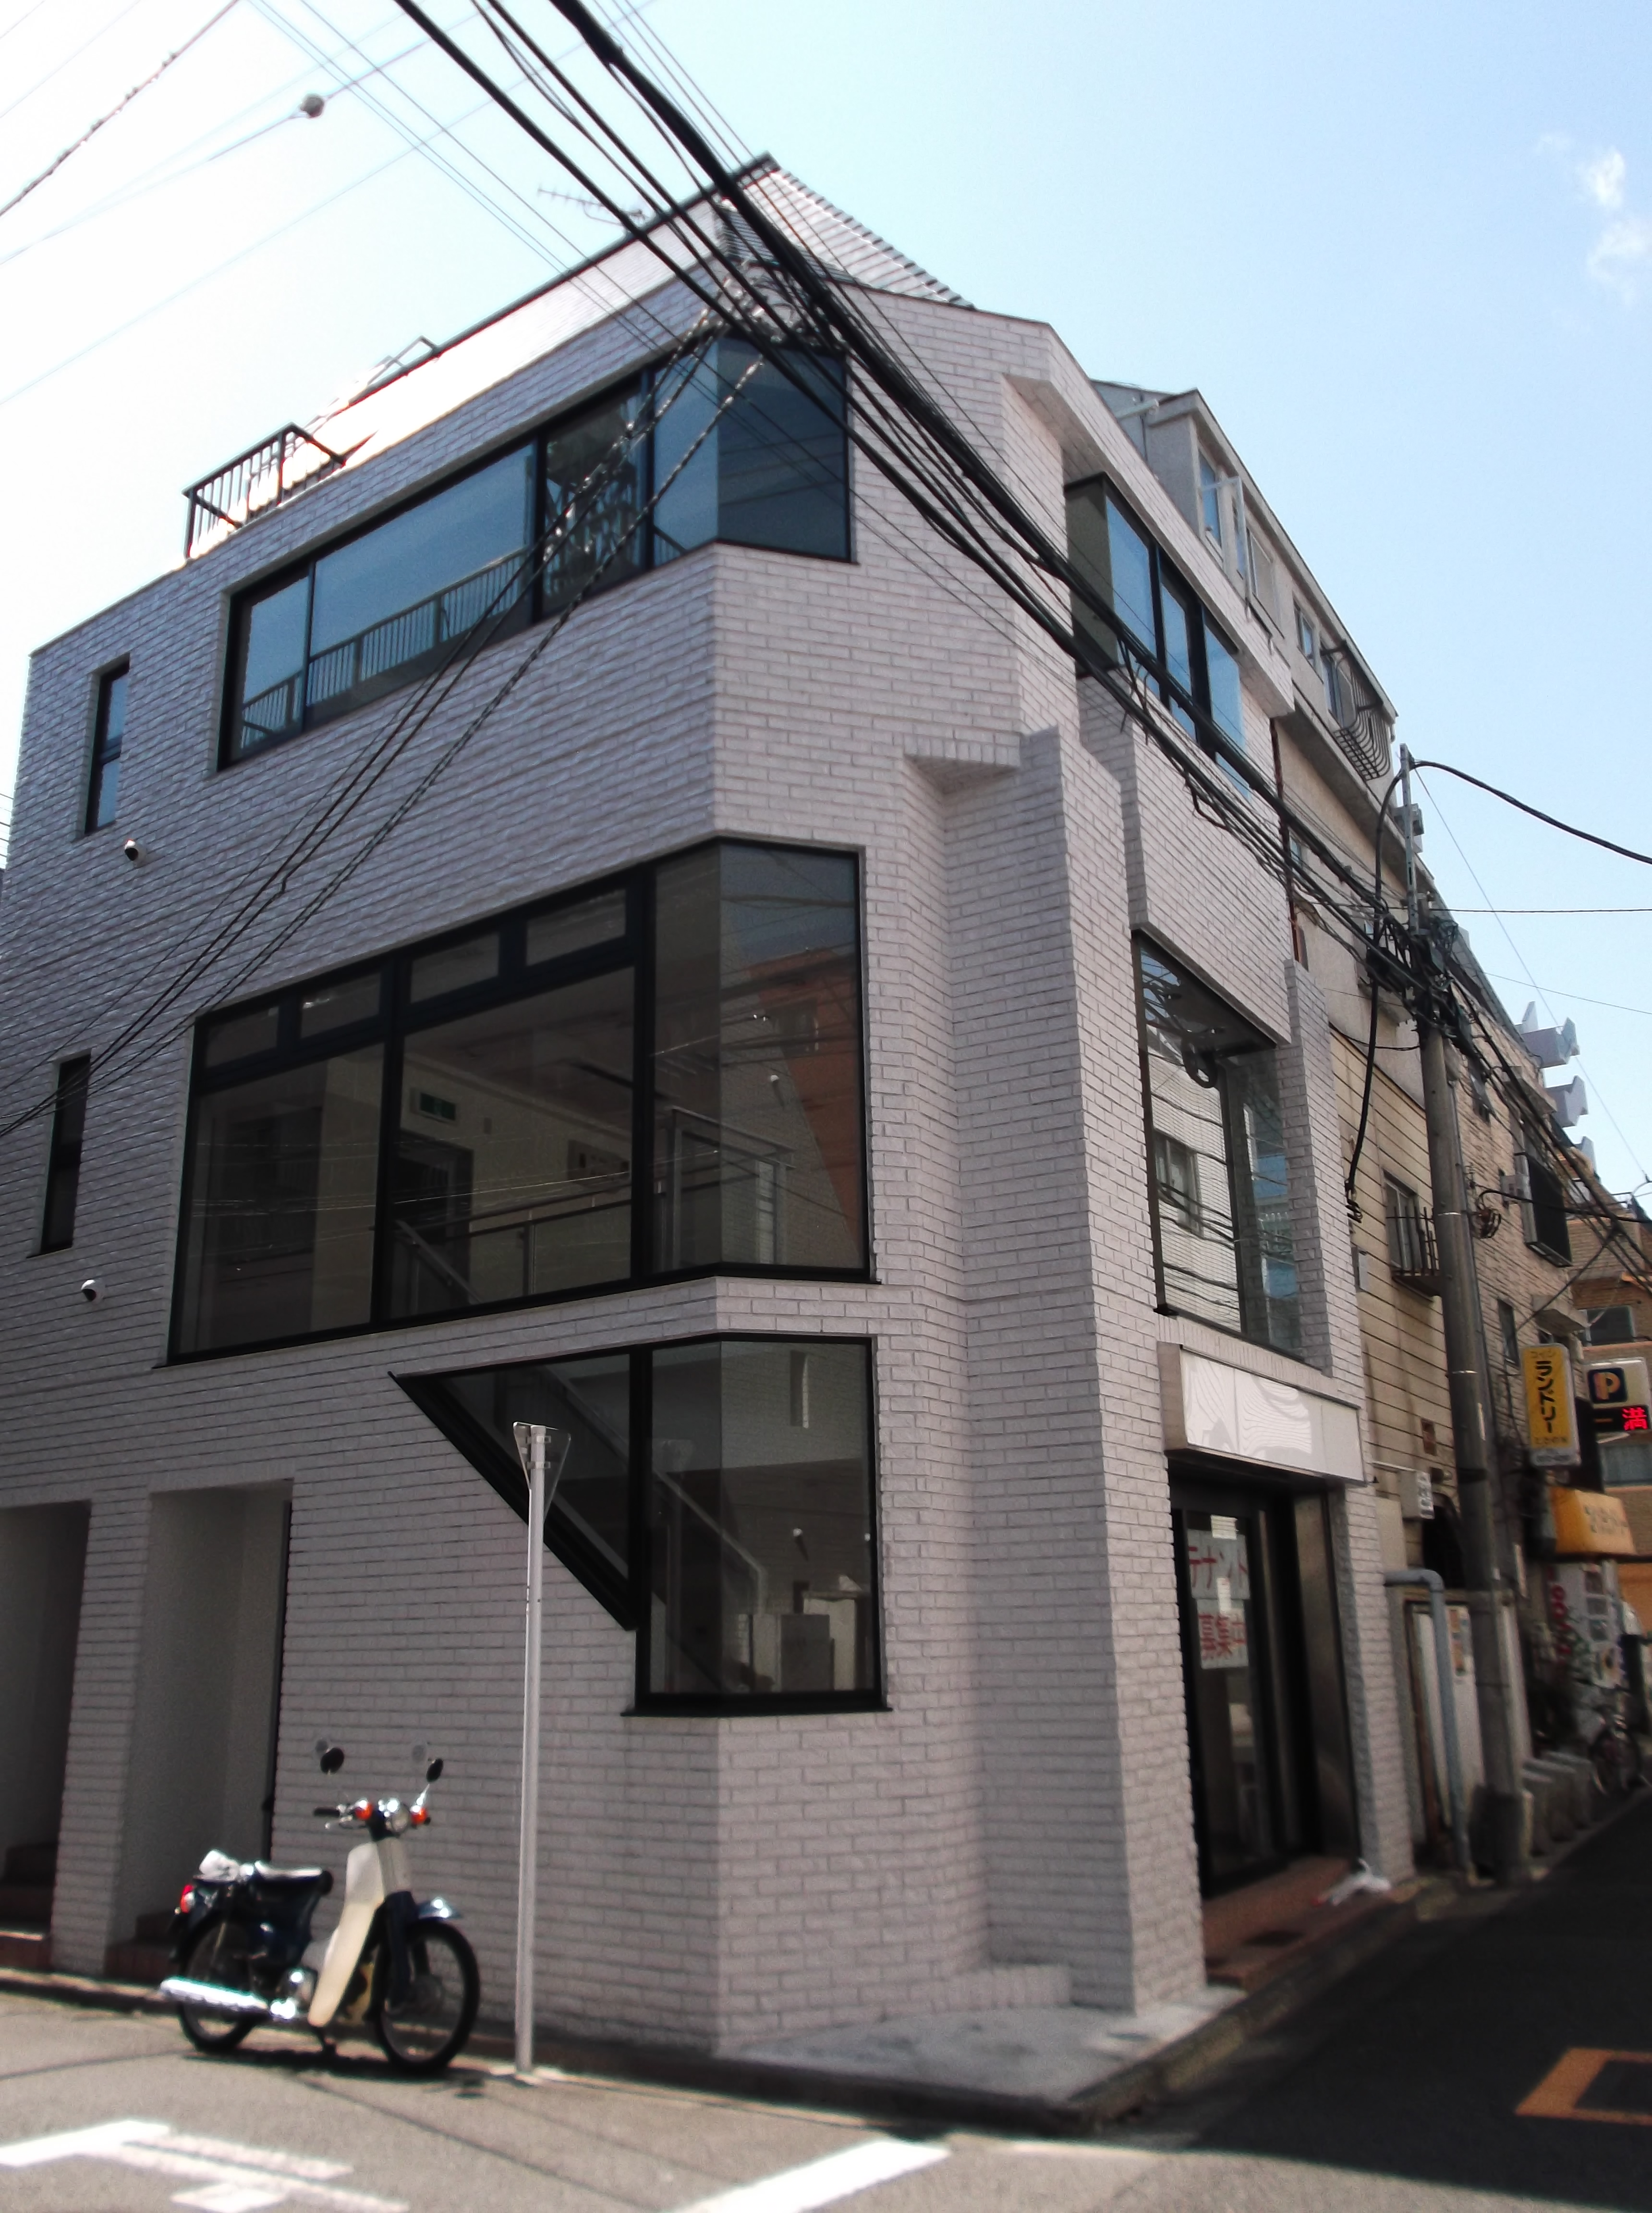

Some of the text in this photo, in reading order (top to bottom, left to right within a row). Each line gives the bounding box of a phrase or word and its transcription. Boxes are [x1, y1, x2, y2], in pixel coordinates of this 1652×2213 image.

[1535, 1361, 1556, 1434] ランドリー
[1594, 1372, 1620, 1400] P
[1622, 1407, 1648, 1431] 満
